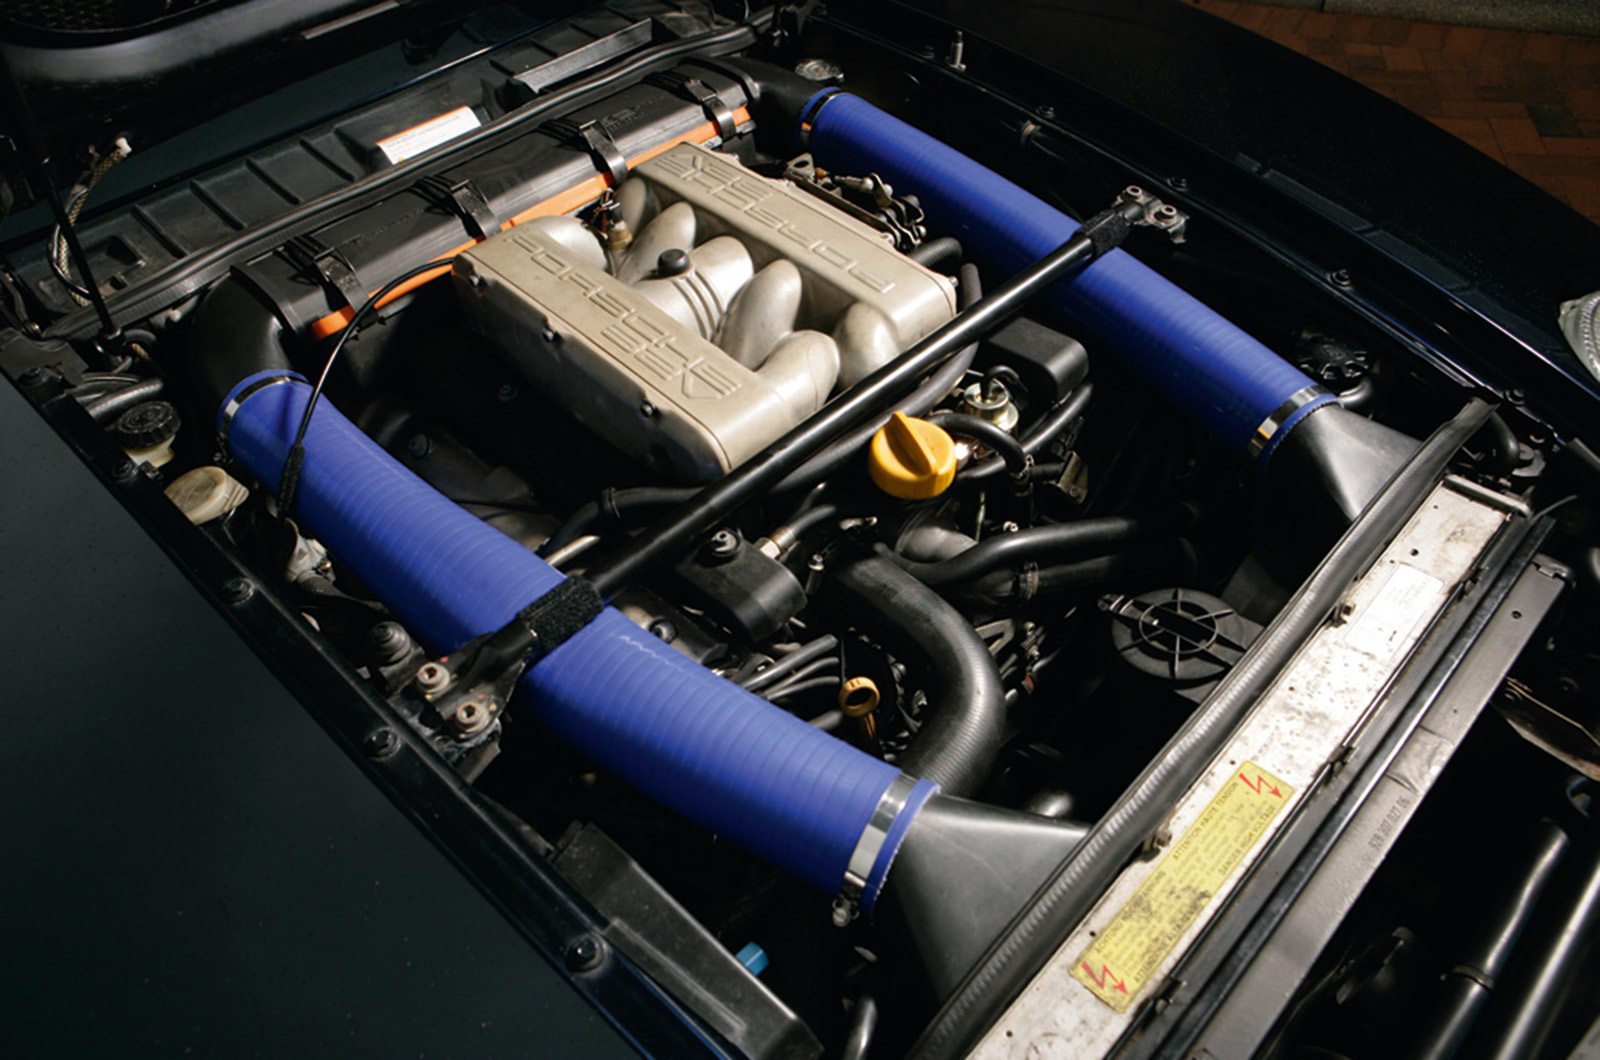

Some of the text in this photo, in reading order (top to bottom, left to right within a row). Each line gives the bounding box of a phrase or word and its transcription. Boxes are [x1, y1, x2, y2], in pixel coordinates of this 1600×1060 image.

[653, 154, 897, 294] PORSCHE
[502, 233, 742, 396] PORSCHE
[600, 321, 724, 400] 32V
[1172, 826, 1202, 860] ATTENTION
